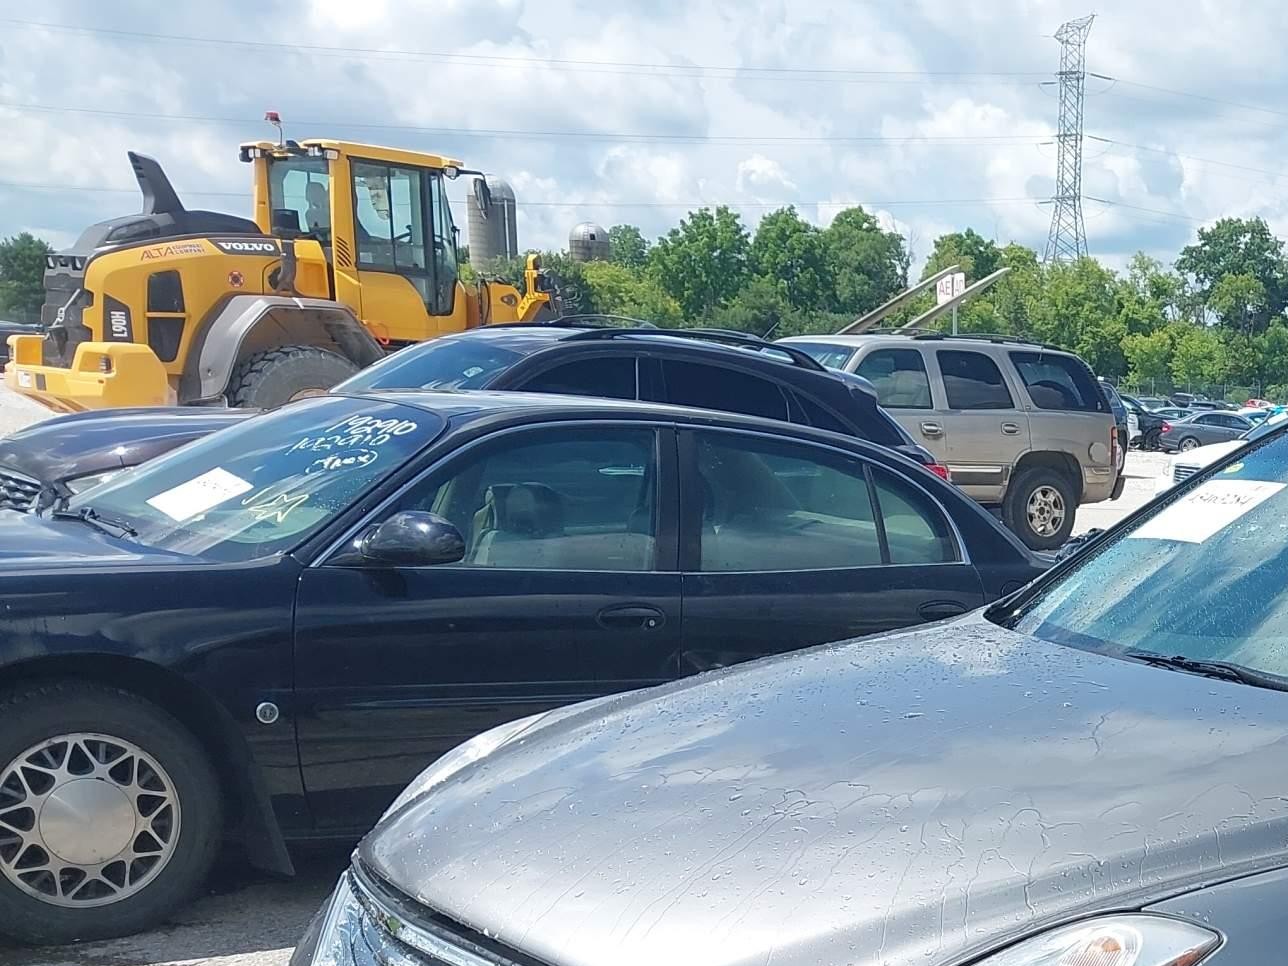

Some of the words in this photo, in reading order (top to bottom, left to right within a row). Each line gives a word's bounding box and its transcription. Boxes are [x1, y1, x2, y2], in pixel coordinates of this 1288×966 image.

[140, 246, 174, 261] ALTA
[217, 242, 275, 252] VOLVO
[110, 310, 128, 338] L90H
